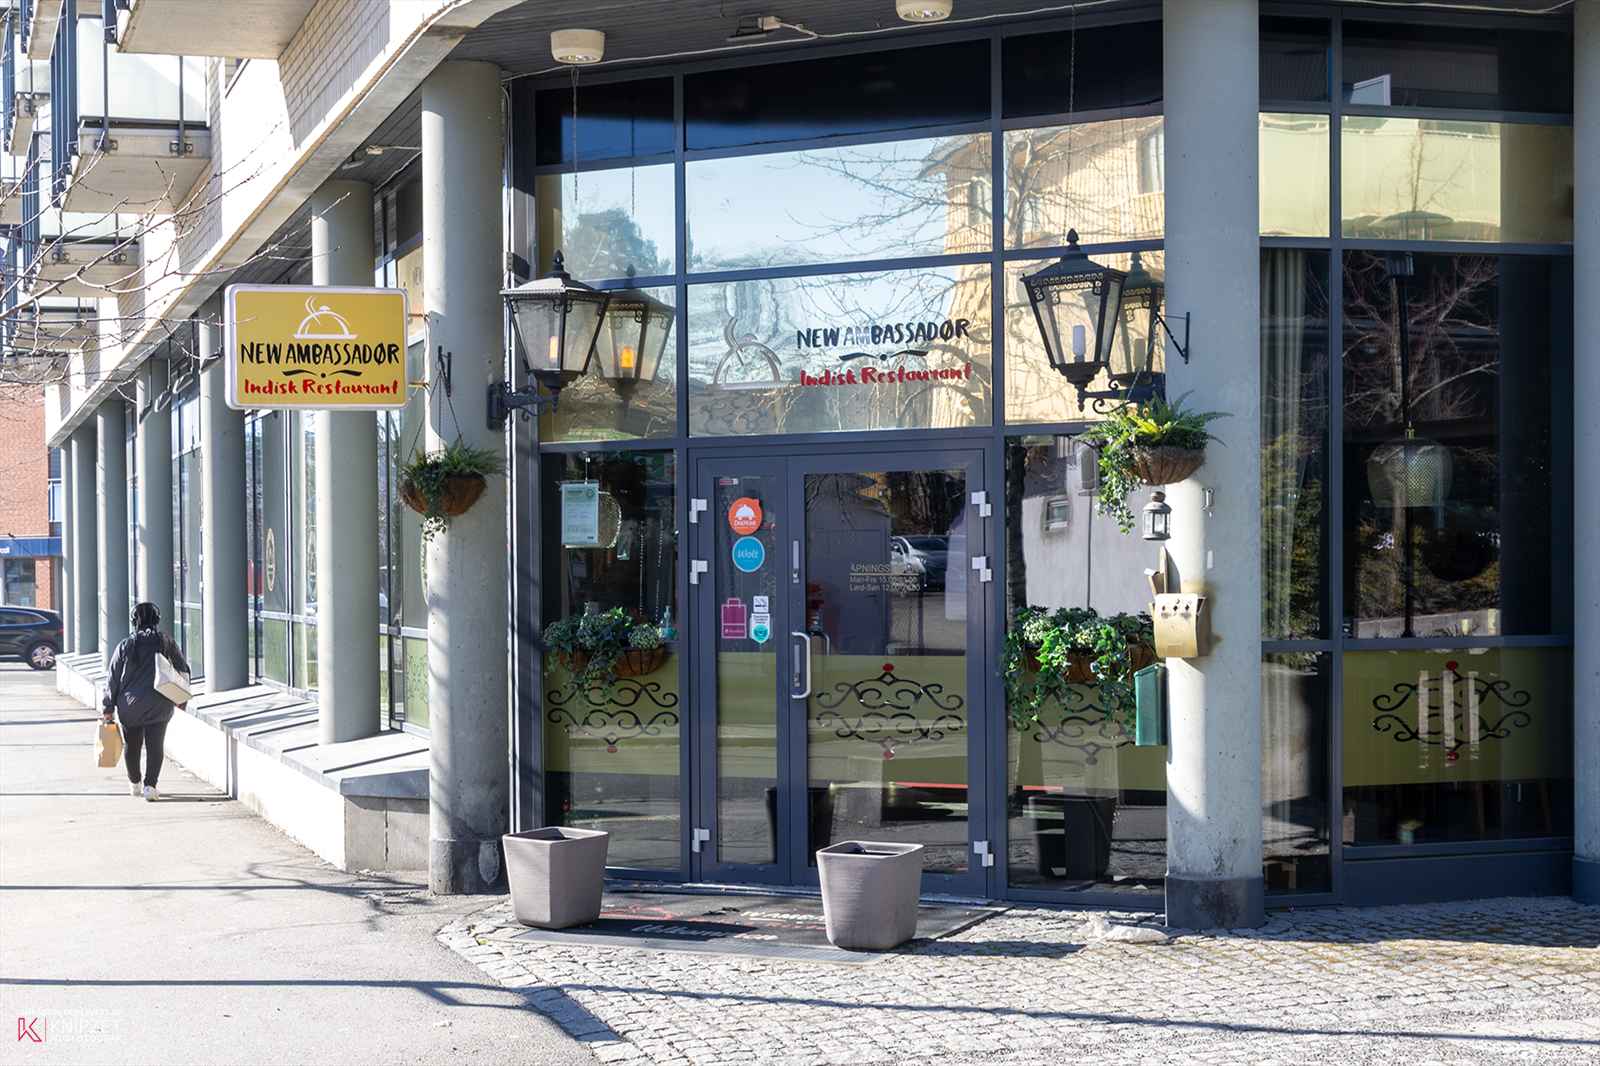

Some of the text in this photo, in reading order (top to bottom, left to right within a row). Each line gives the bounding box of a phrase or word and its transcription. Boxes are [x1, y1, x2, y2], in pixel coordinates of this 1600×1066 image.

[797, 319, 970, 349] NEW AMBASSADØR
[241, 341, 400, 366] NEW AMBASSADØR
[244, 379, 398, 394] Indisk Restaurant
[800, 362, 972, 387] Indisk Restaurant
[738, 549, 760, 558] Wolt
